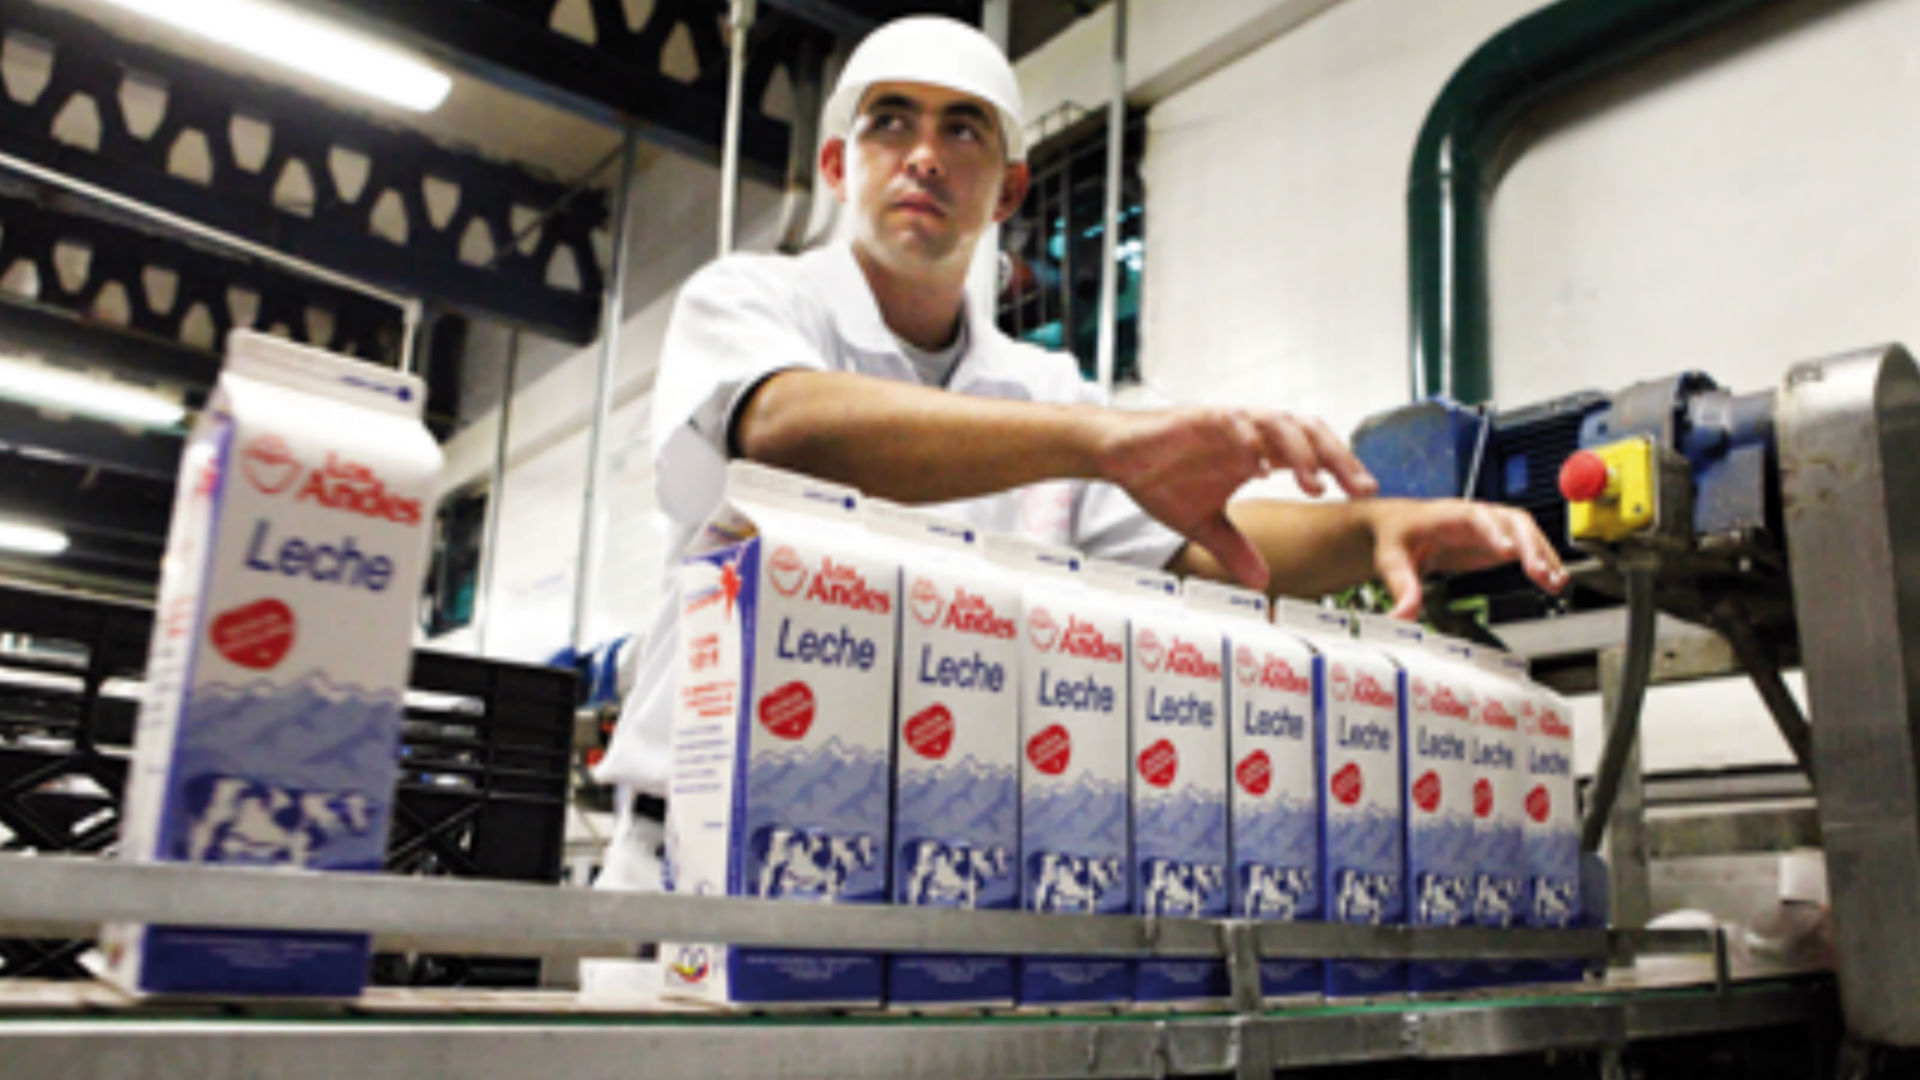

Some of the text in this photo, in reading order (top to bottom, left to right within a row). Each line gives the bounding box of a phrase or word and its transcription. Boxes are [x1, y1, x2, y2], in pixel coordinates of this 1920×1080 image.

[326, 451, 373, 478] Los
[294, 470, 420, 527] Andes
[245, 519, 394, 591] Leche
[822, 555, 857, 581] Los
[806, 573, 890, 615] Andes
[955, 585, 985, 609] Los
[941, 603, 1017, 640] Andes
[776, 618, 875, 671] Leche
[1057, 630, 1123, 663] Andes
[919, 643, 1004, 693] Leche
[1164, 648, 1223, 682] Andes
[1037, 668, 1115, 714] Leche
[1145, 686, 1215, 729] Leche
[1244, 701, 1304, 741] Leche
[1336, 715, 1391, 753] Leche
